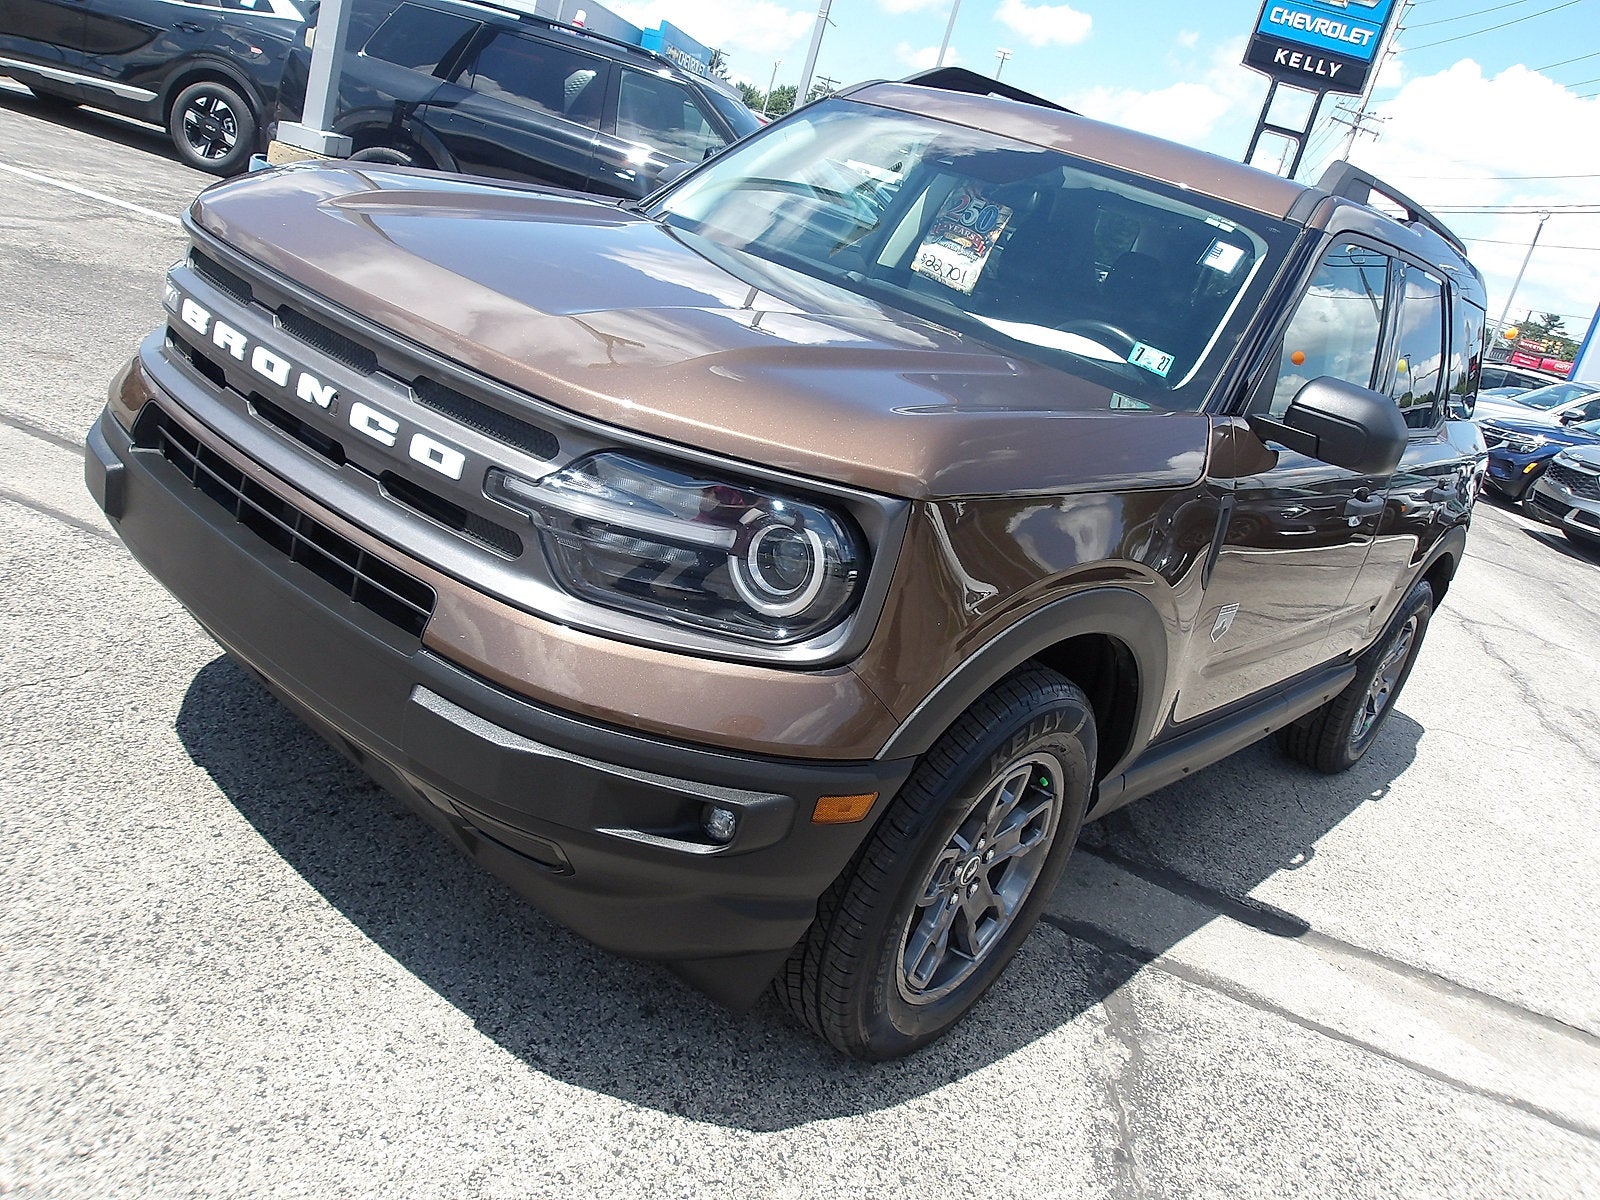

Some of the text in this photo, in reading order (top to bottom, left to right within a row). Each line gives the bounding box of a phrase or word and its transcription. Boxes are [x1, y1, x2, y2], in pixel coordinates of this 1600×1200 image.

[1269, 6, 1375, 46] CHEVROLET
[678, 50, 707, 77] CHEVROLET
[1273, 48, 1343, 78] KELLY
[943, 194, 1000, 234] 250
[948, 223, 976, 242] YEARS
[920, 253, 968, 284] $22,701
[1135, 346, 1146, 361] 7
[1156, 355, 1171, 372] 27
[181, 298, 466, 481] BRONCO
[990, 710, 1067, 775] KELLY
